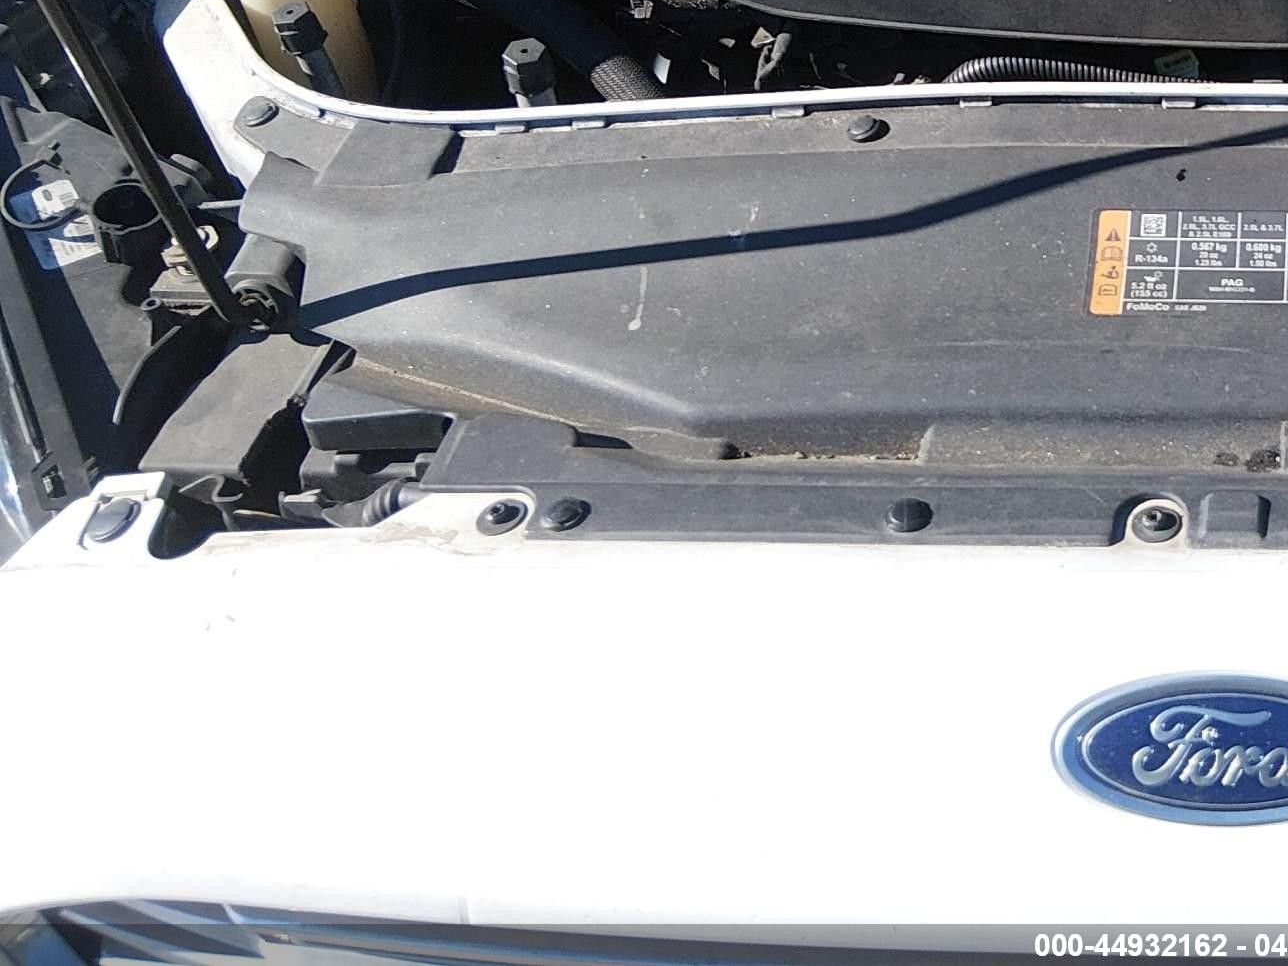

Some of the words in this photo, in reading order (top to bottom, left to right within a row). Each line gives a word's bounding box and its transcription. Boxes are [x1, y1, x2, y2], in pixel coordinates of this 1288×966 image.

[1215, 242, 1228, 253] kg
[1270, 243, 1282, 253] kg
[1134, 255, 1169, 263] R-134a
[1130, 282, 1146, 290] 5.2
[1221, 278, 1244, 286] PAG
[1130, 290, 1151, 298] (155
[1152, 290, 1168, 298] cc)
[1126, 303, 1170, 311] FoMoCo
